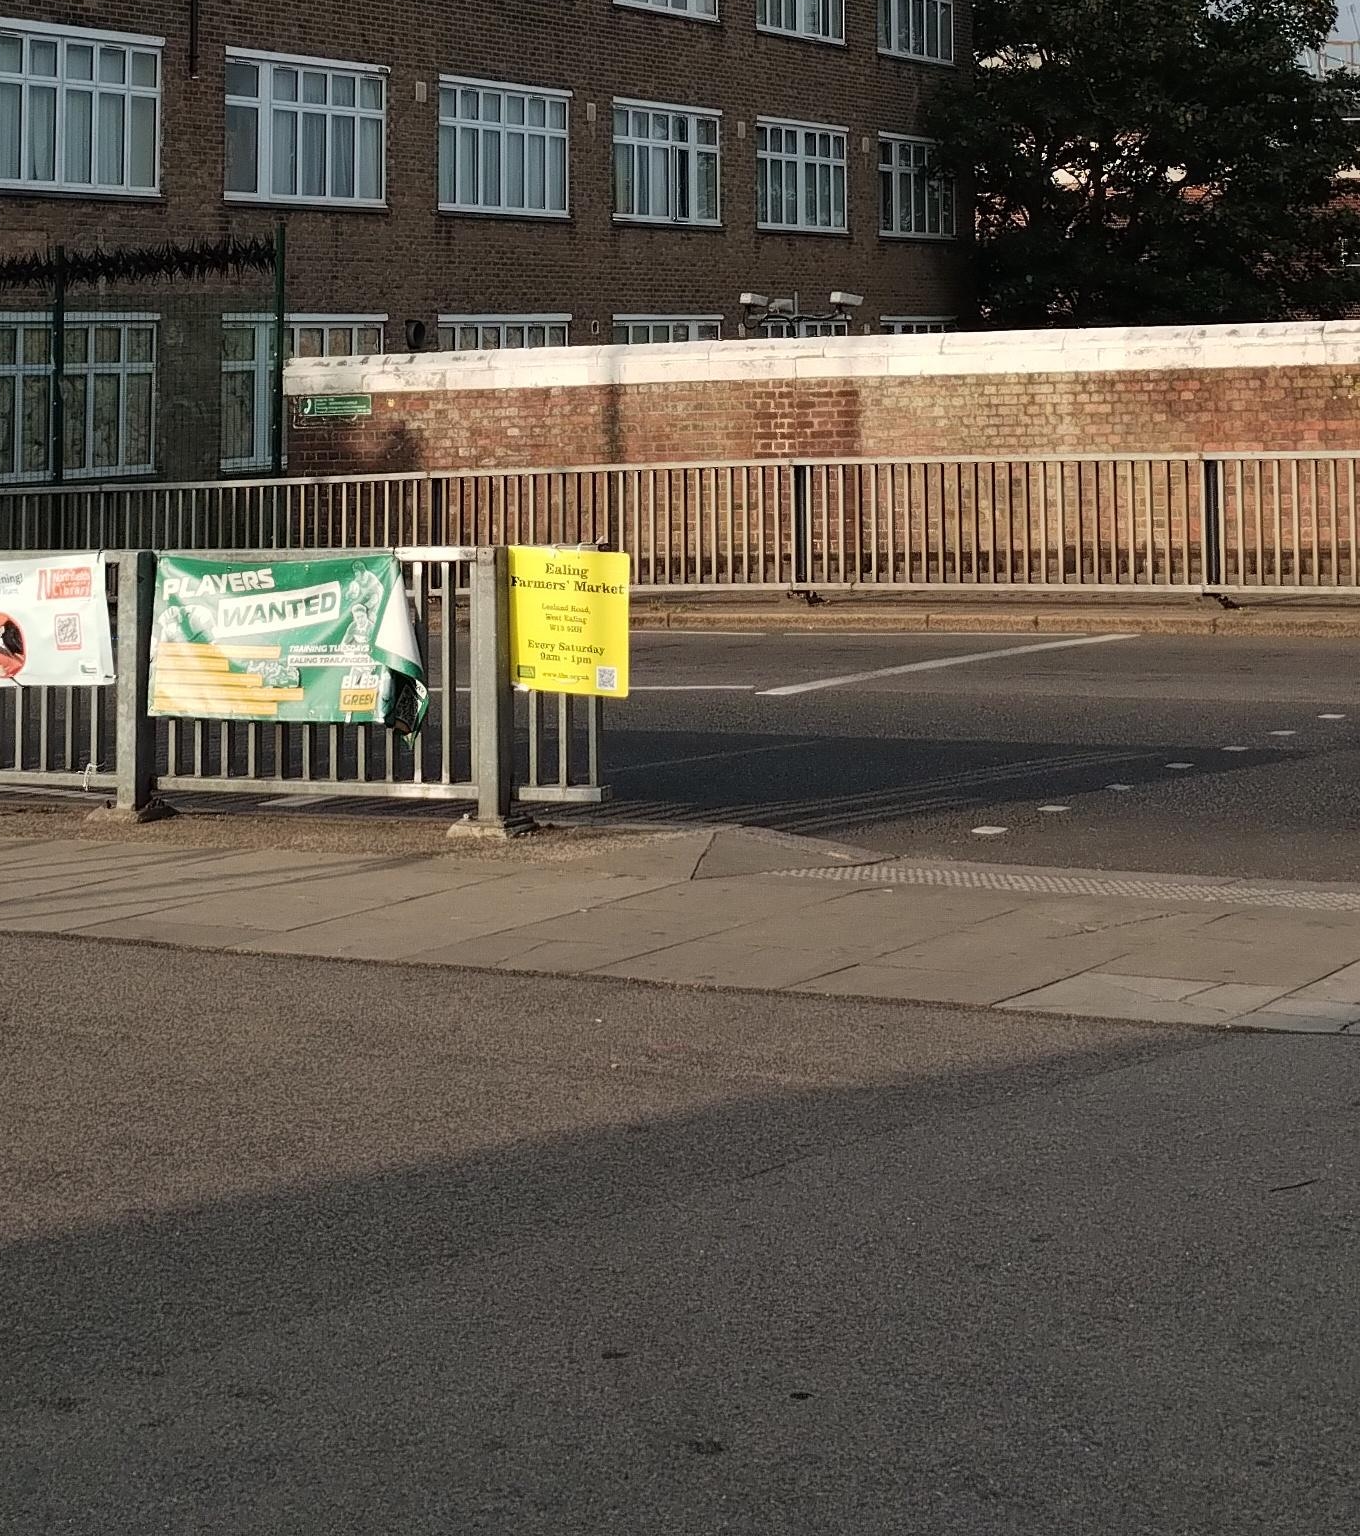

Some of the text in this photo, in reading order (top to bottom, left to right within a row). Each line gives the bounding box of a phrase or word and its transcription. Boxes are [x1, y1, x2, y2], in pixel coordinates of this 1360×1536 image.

[545, 562, 589, 579] Ealing
[163, 567, 275, 600] PLAYERS
[511, 575, 625, 595] Farmers' Market
[223, 591, 338, 628] WANTED
[289, 645, 327, 653] TRAINING
[528, 639, 605, 656] Every Saturday
[540, 652, 561, 662] 9am
[571, 654, 592, 664] 1pm
